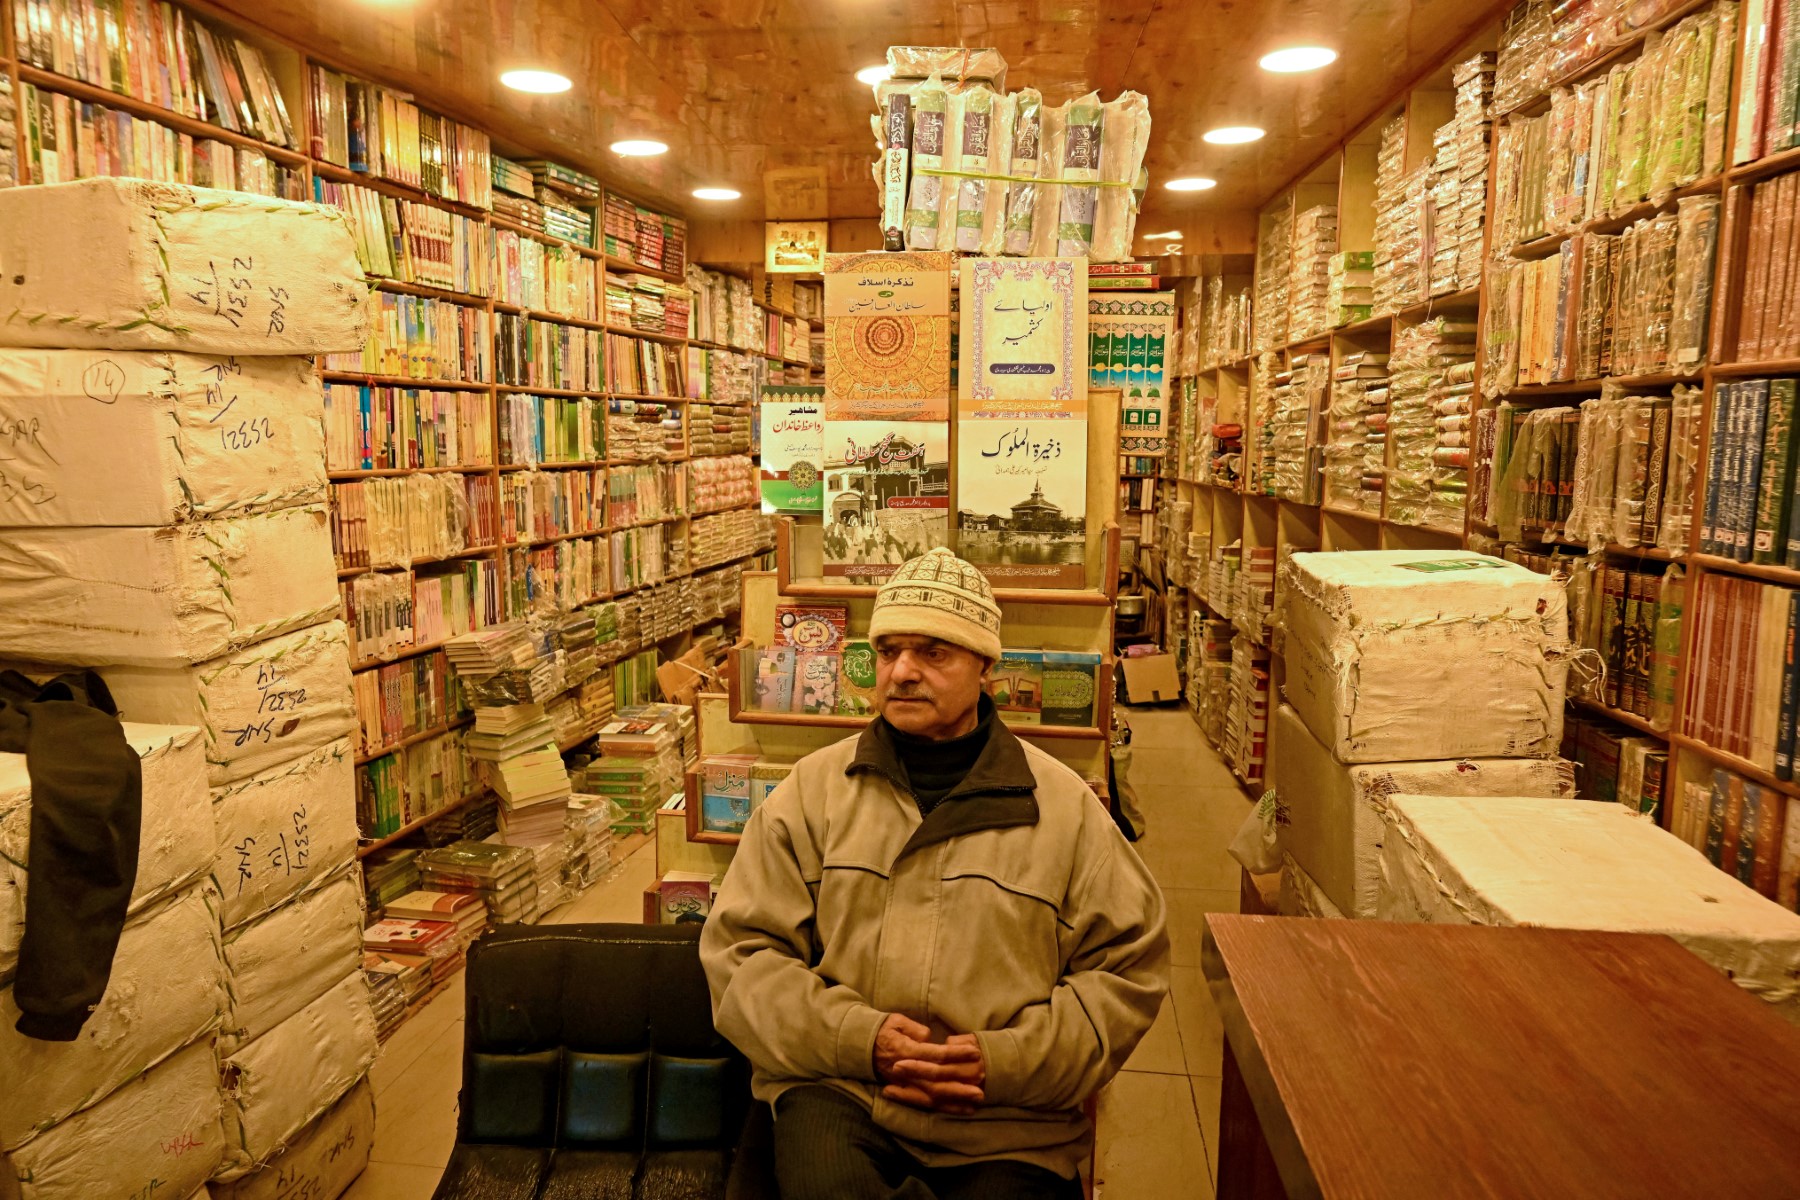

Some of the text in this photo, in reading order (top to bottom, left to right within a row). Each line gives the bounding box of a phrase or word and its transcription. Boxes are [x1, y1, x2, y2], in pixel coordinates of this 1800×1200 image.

[858, 277, 886, 287] اسلاف
[896, 300, 926, 312] سلطان
[1002, 318, 1044, 346] کشمیر
[94, 367, 115, 395] 14
[221, 417, 275, 450] 25321
[772, 420, 801, 433] خاندان
[844, 431, 925, 465] ہفت گنج سلطانی
[257, 664, 275, 685] 14
[258, 688, 307, 714] 25321
[222, 717, 275, 747] SNR
[292, 804, 309, 870] 25321
